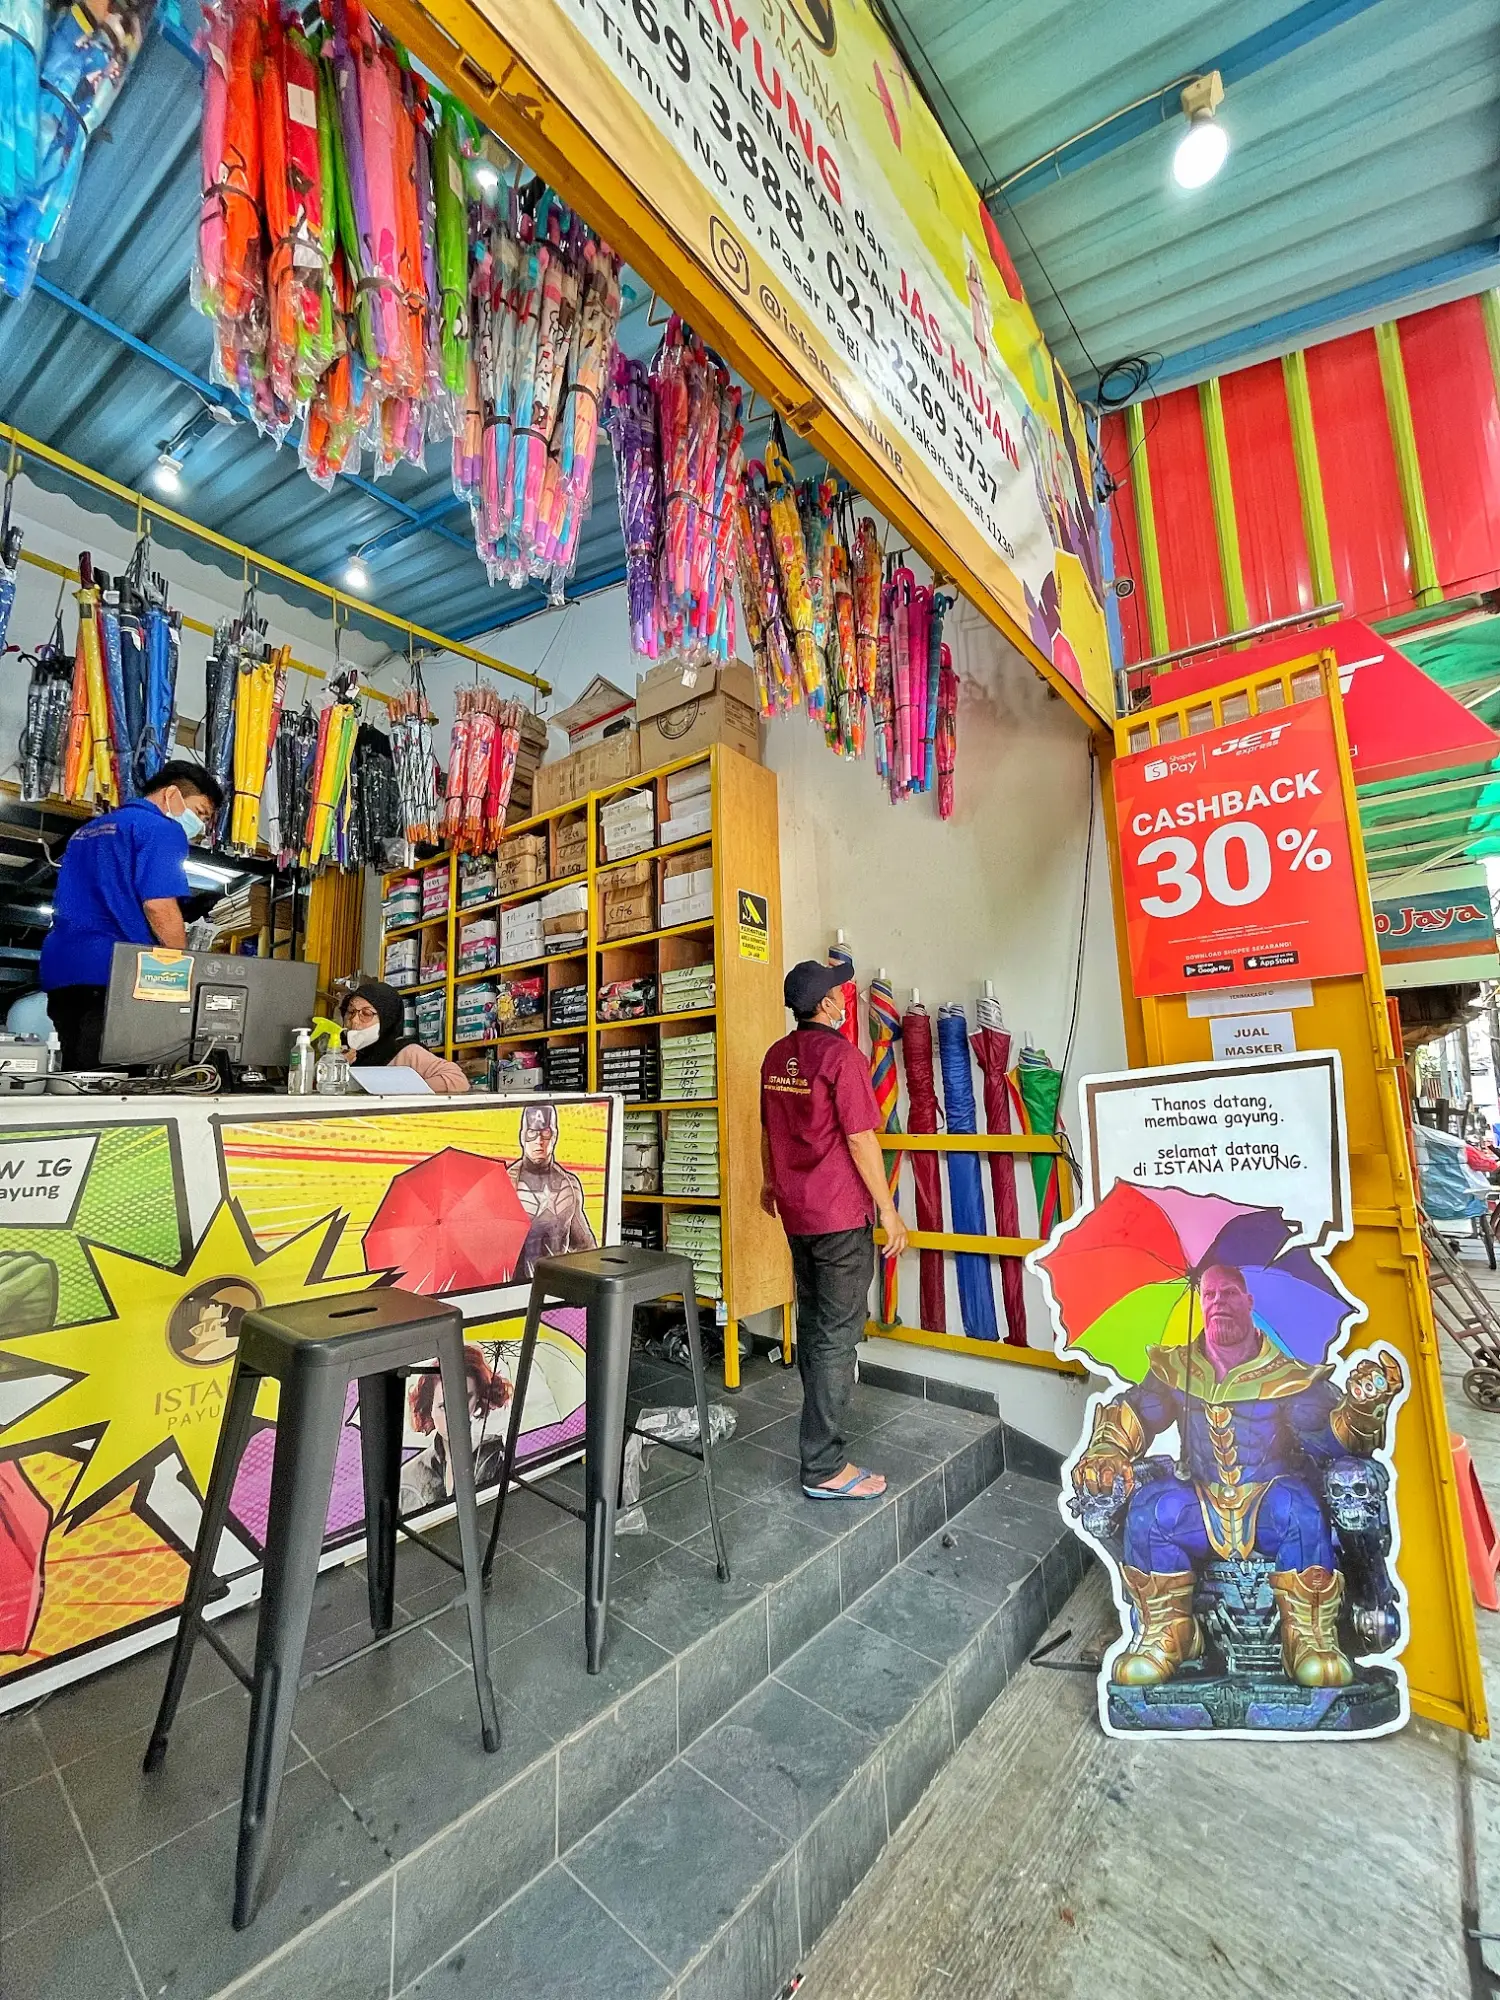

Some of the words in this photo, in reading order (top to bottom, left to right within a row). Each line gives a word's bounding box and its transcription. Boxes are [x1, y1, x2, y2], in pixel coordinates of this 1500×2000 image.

[596, 0, 684, 128] Timur
[693, 126, 735, 198] No.
[769, 226, 821, 308] Pasar
[826, 303, 860, 364] Pagi
[911, 415, 954, 482] Jakarta
[956, 470, 985, 523] Barat
[986, 514, 1015, 560] 11230
[854, 209, 889, 270] dan
[898, 267, 944, 357] JAS
[950, 343, 1021, 472] HUJAN
[855, 244, 896, 319] DAN
[896, 308, 984, 445] TERMURAH
[826, 250, 947, 437] 021-2269
[953, 426, 1000, 505] 3737
[1211, 722, 1292, 757] JET
[1235, 740, 1279, 757] express
[1169, 751, 1197, 763] Shopee
[1169, 760, 1198, 775] Pay
[1131, 768, 1323, 838] CASHBACK
[1390, 904, 1488, 936] Jaya
[1185, 951, 1222, 961] DOWNLOAD
[1223, 947, 1250, 956] SHOPEE
[1251, 941, 1293, 952] SEKARANG!
[226, 963, 245, 976] LG
[1234, 1027, 1270, 1038] JUAL
[1225, 1043, 1283, 1056] MASKER
[1152, 1098, 1206, 1111] Thanos
[1213, 1094, 1273, 1111] datang,
[1145, 1113, 1218, 1128] membawa
[1224, 1111, 1285, 1128] gayung.
[1158, 1144, 1218, 1160] selamat
[1225, 1141, 1279, 1157] datang
[36, 1158, 72, 1178] IG
[1133, 1162, 1147, 1177] di
[1154, 1158, 1224, 1175] ISTANA
[1230, 1154, 1308, 1172] PAYUNG.
[154, 1376, 238, 1416] ISTA
[167, 1404, 221, 1431] PAYU
